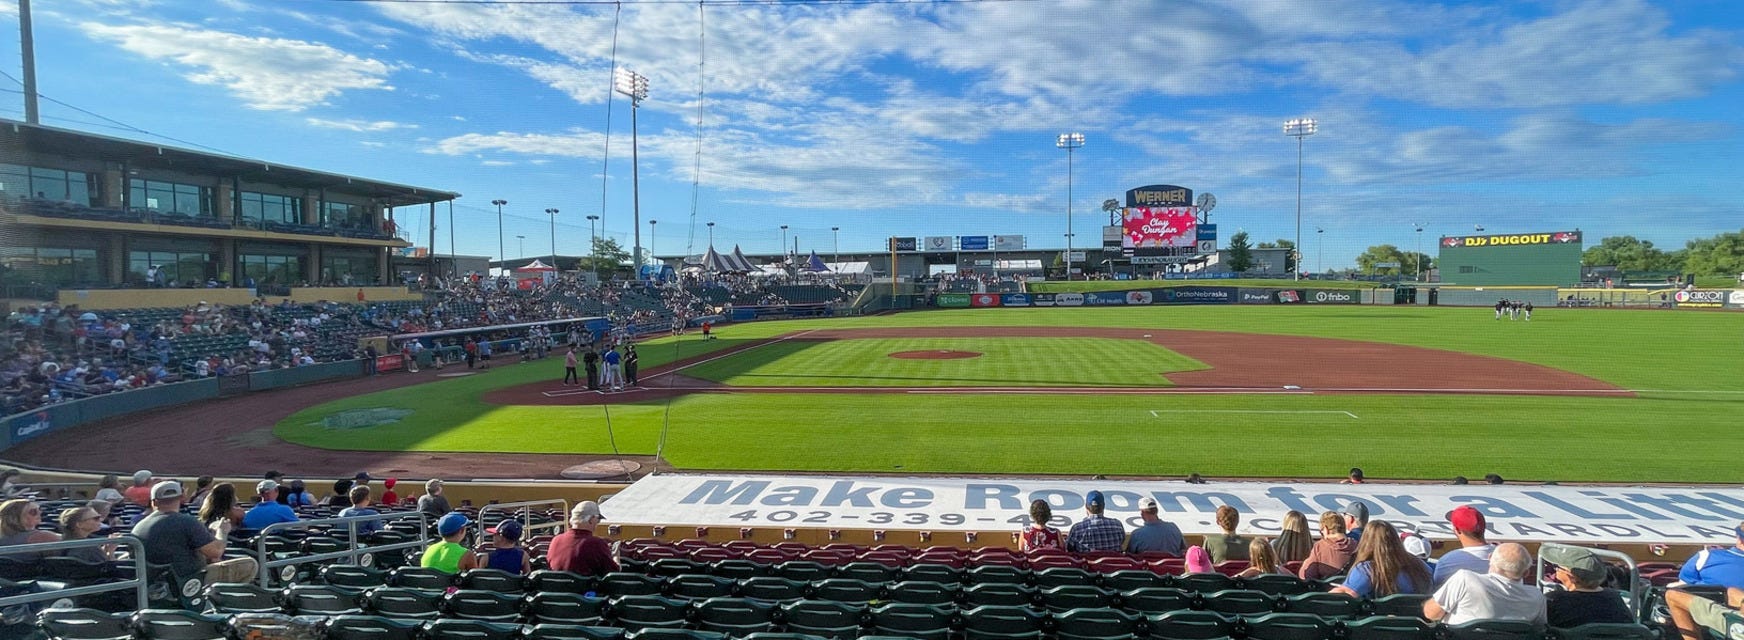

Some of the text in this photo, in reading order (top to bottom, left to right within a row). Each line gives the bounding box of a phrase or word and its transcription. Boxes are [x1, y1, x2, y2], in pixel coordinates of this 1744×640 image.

[1134, 189, 1186, 203] WERNER
[1149, 218, 1170, 228] Clay
[1490, 234, 1551, 245] DUGOUT
[1328, 292, 1351, 301] fnbo
[677, 480, 935, 508] Make
[964, 483, 1257, 513] Room
[1264, 486, 1431, 516] for
[1448, 495, 1544, 518] a
